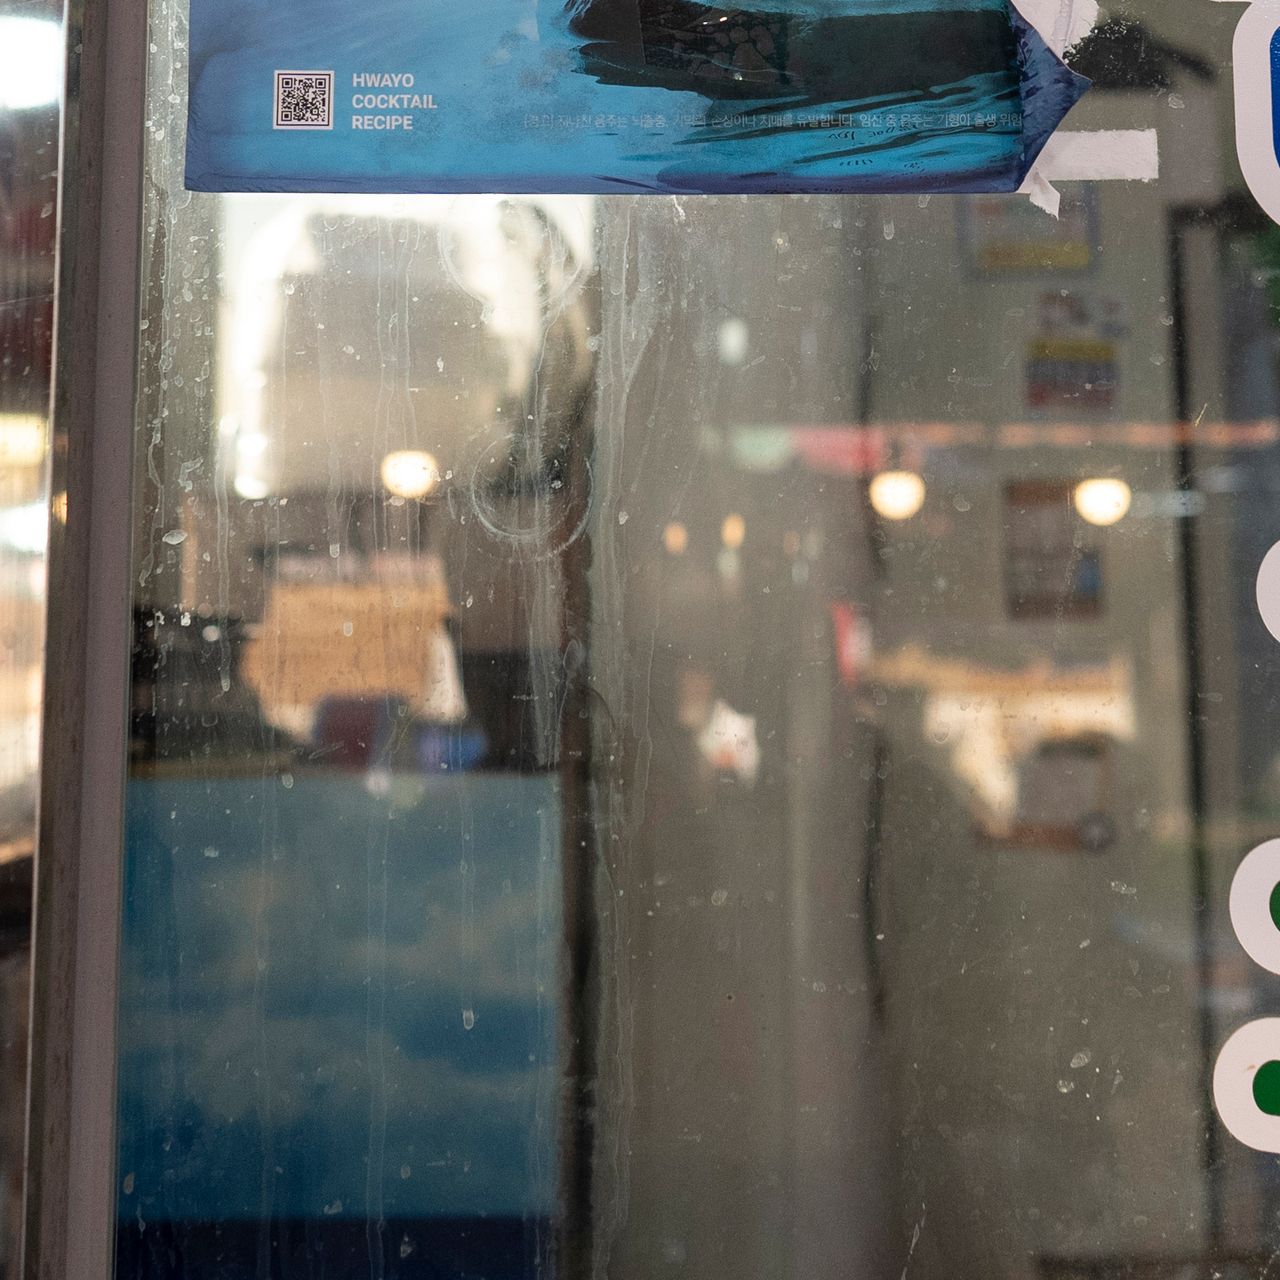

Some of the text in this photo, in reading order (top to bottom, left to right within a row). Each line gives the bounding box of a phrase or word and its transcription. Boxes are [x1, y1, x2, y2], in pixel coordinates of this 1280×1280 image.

[352, 73, 414, 88] HWAYO
[352, 94, 437, 109] COCKTAIL
[351, 115, 413, 130] RECIPE
